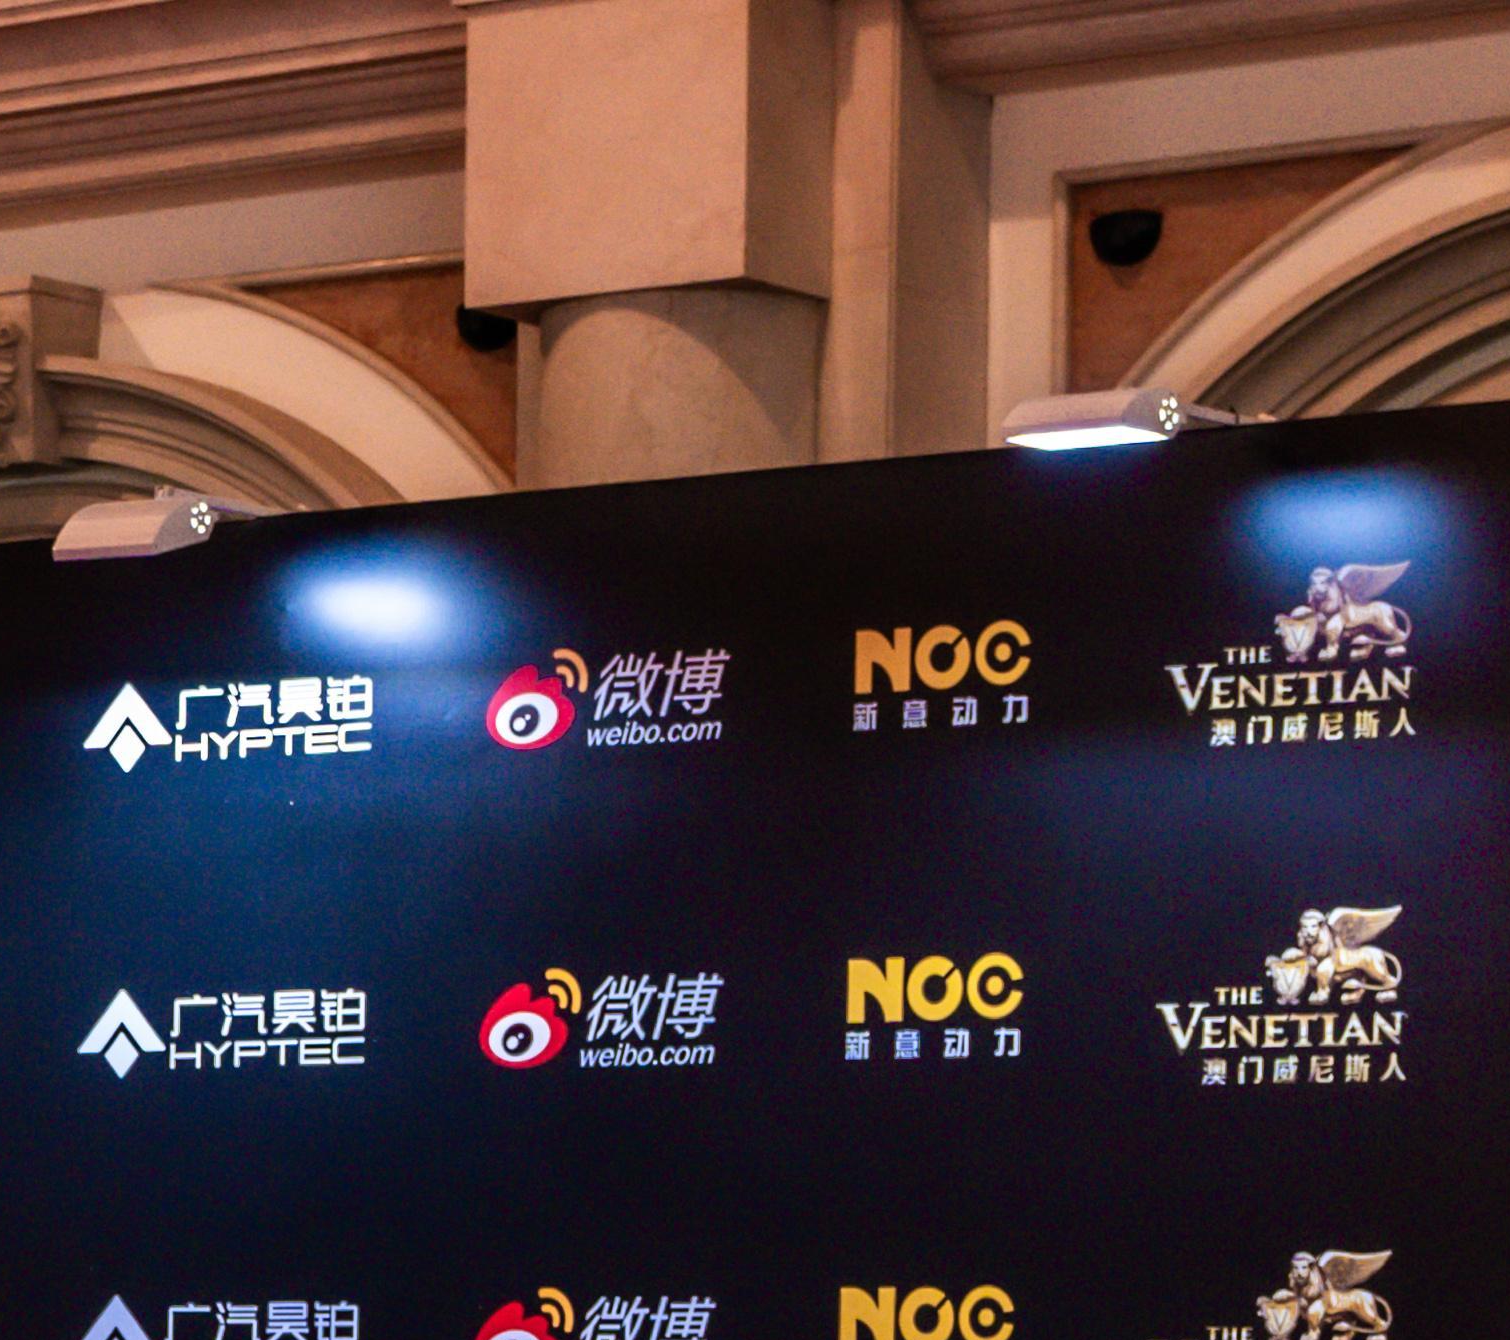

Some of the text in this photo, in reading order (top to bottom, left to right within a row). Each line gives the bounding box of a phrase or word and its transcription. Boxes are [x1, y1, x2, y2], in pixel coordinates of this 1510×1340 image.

[855, 620, 1031, 694] NOC
[1225, 647, 1271, 664] THE
[176, 675, 372, 730] 广汽昊铂
[594, 649, 730, 721] 微博
[1165, 663, 1412, 711] VENETIAN
[588, 721, 722, 746] weibo.com
[853, 695, 1028, 730] 新意动力
[1210, 708, 1415, 746] 澳门威尼斯人
[175, 722, 372, 762] HYPTEC
[587, 972, 724, 1042] 微博
[846, 952, 1023, 1023] NOC
[1215, 987, 1262, 1005] THE
[1156, 1003, 1407, 1049] VENETIAN
[169, 1034, 365, 1070] HYPTEC
